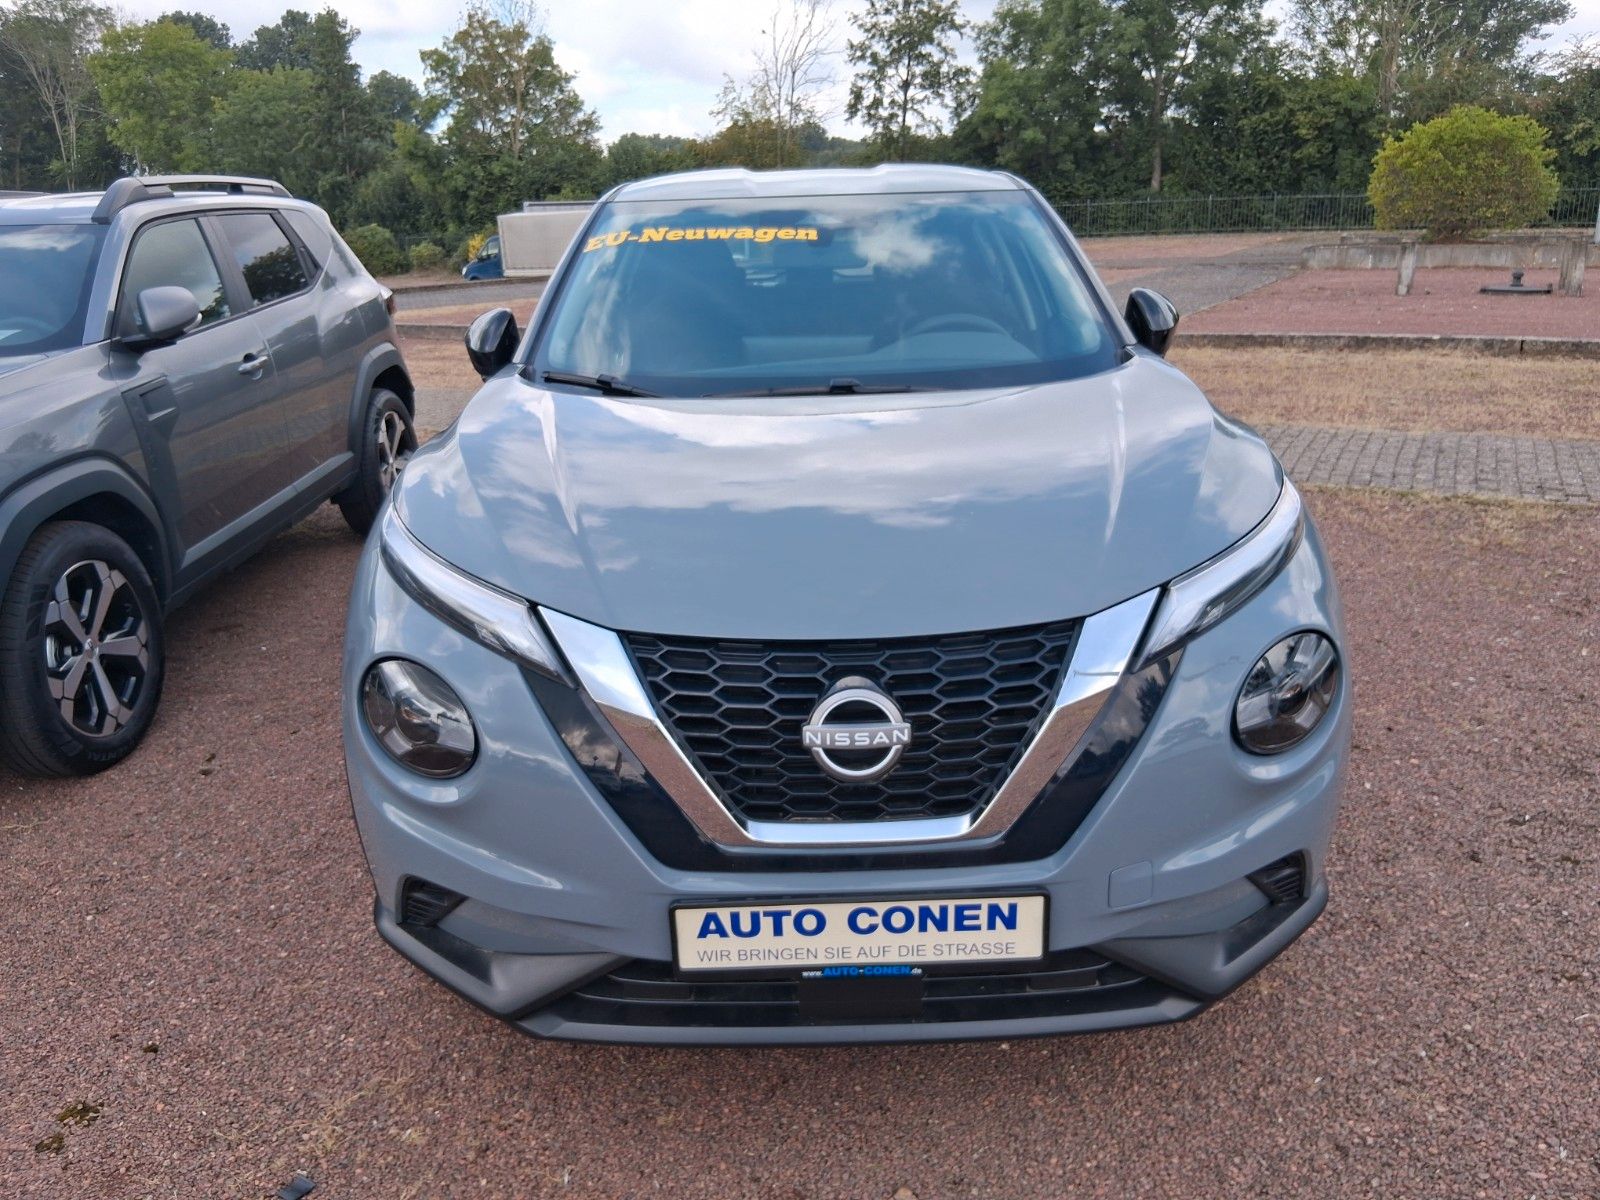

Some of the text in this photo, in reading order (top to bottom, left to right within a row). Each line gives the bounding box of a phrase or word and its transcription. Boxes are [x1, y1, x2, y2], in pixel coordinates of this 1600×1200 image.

[584, 226, 819, 253] EU-Neuwagen
[805, 728, 910, 746] NISSAN
[697, 903, 1018, 939] AUTO CONEN
[697, 941, 1017, 963] WIR BRINGEN SIE AUF DIE STRASSE
